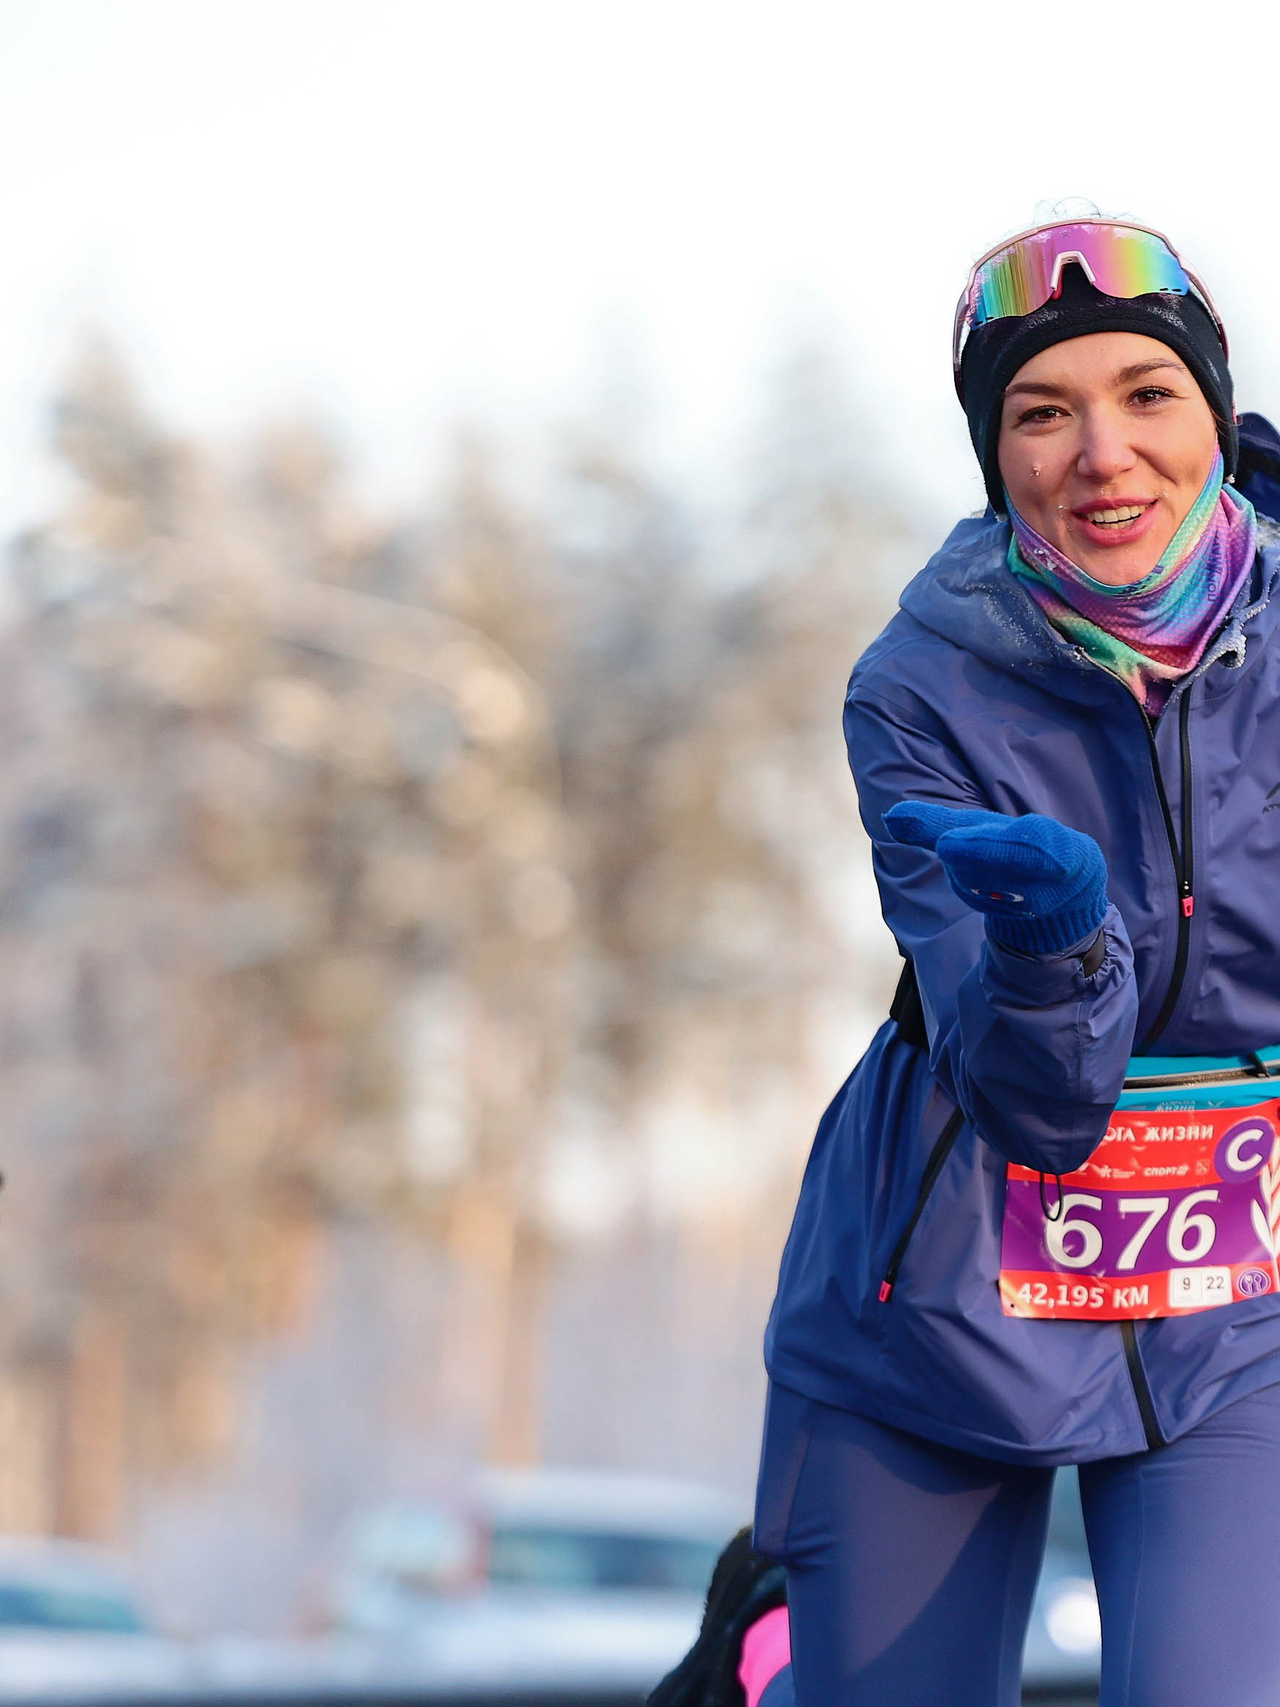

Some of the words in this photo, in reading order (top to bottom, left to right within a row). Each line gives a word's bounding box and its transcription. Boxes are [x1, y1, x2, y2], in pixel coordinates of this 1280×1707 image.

[1104, 1126, 1136, 1142] ОГА
[1144, 1124, 1214, 1142] ЖИЗНИ
[1044, 1189, 1220, 1271] 676
[1182, 1276, 1192, 1291] 9
[1206, 1275, 1225, 1290] 22
[1017, 1282, 1105, 1309] 42,195
